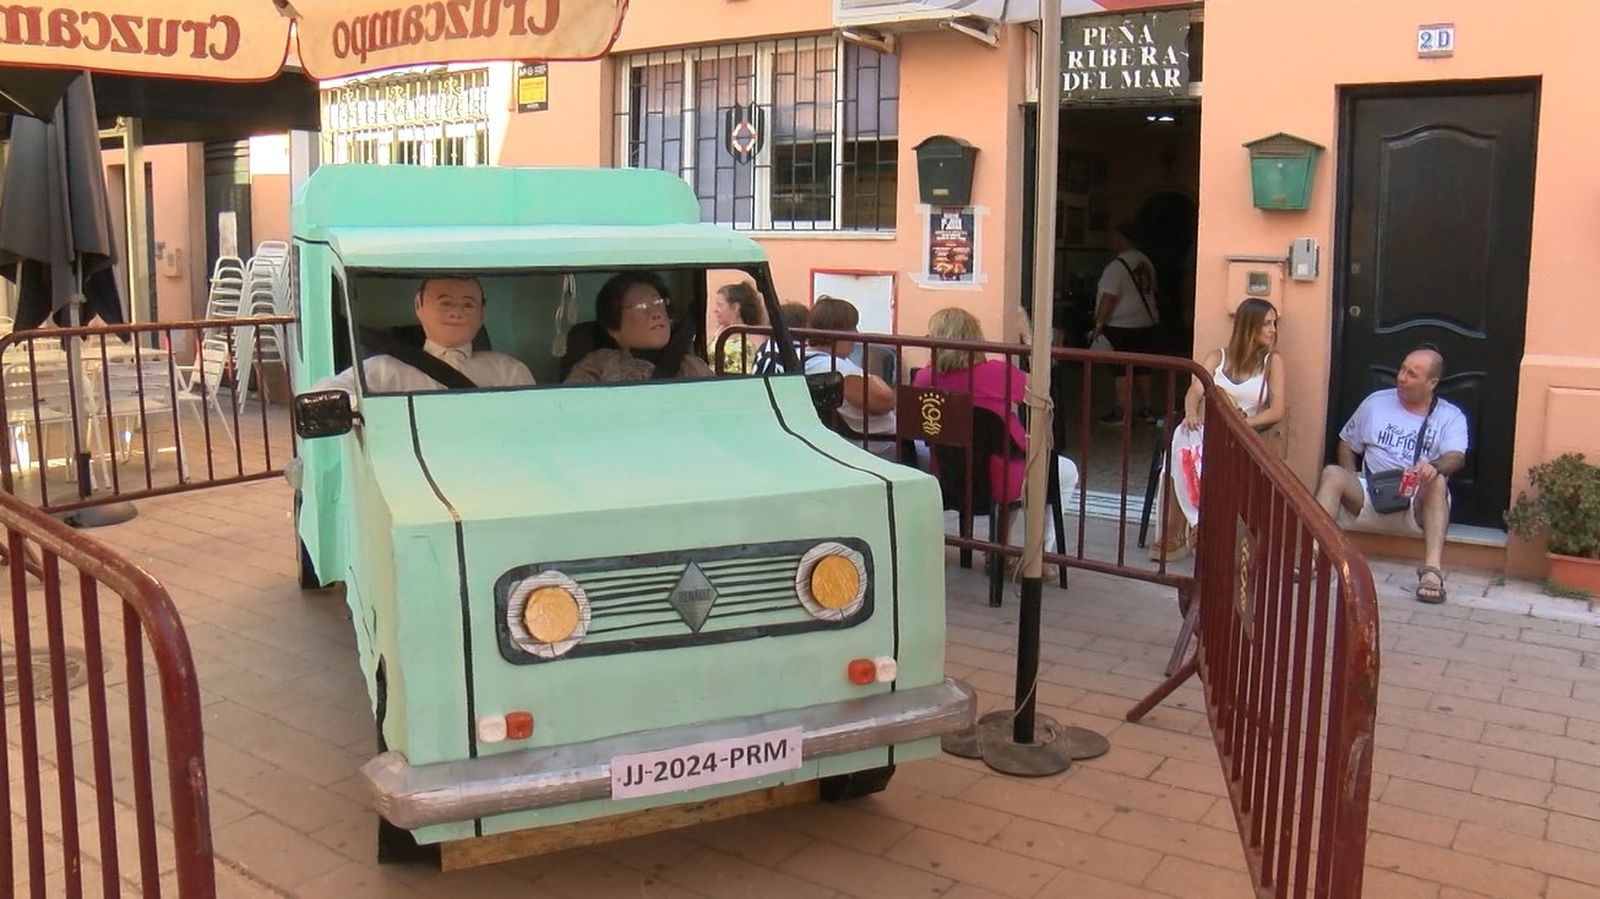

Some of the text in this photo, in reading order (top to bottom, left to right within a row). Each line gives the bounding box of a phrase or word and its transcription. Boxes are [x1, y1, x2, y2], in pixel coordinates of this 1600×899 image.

[1083, 20, 1154, 46] PEÑA
[1067, 46, 1180, 69] RIBERA
[1062, 68, 1182, 91] DEL MAR
[623, 739, 788, 787] JJ-2024-PRM
